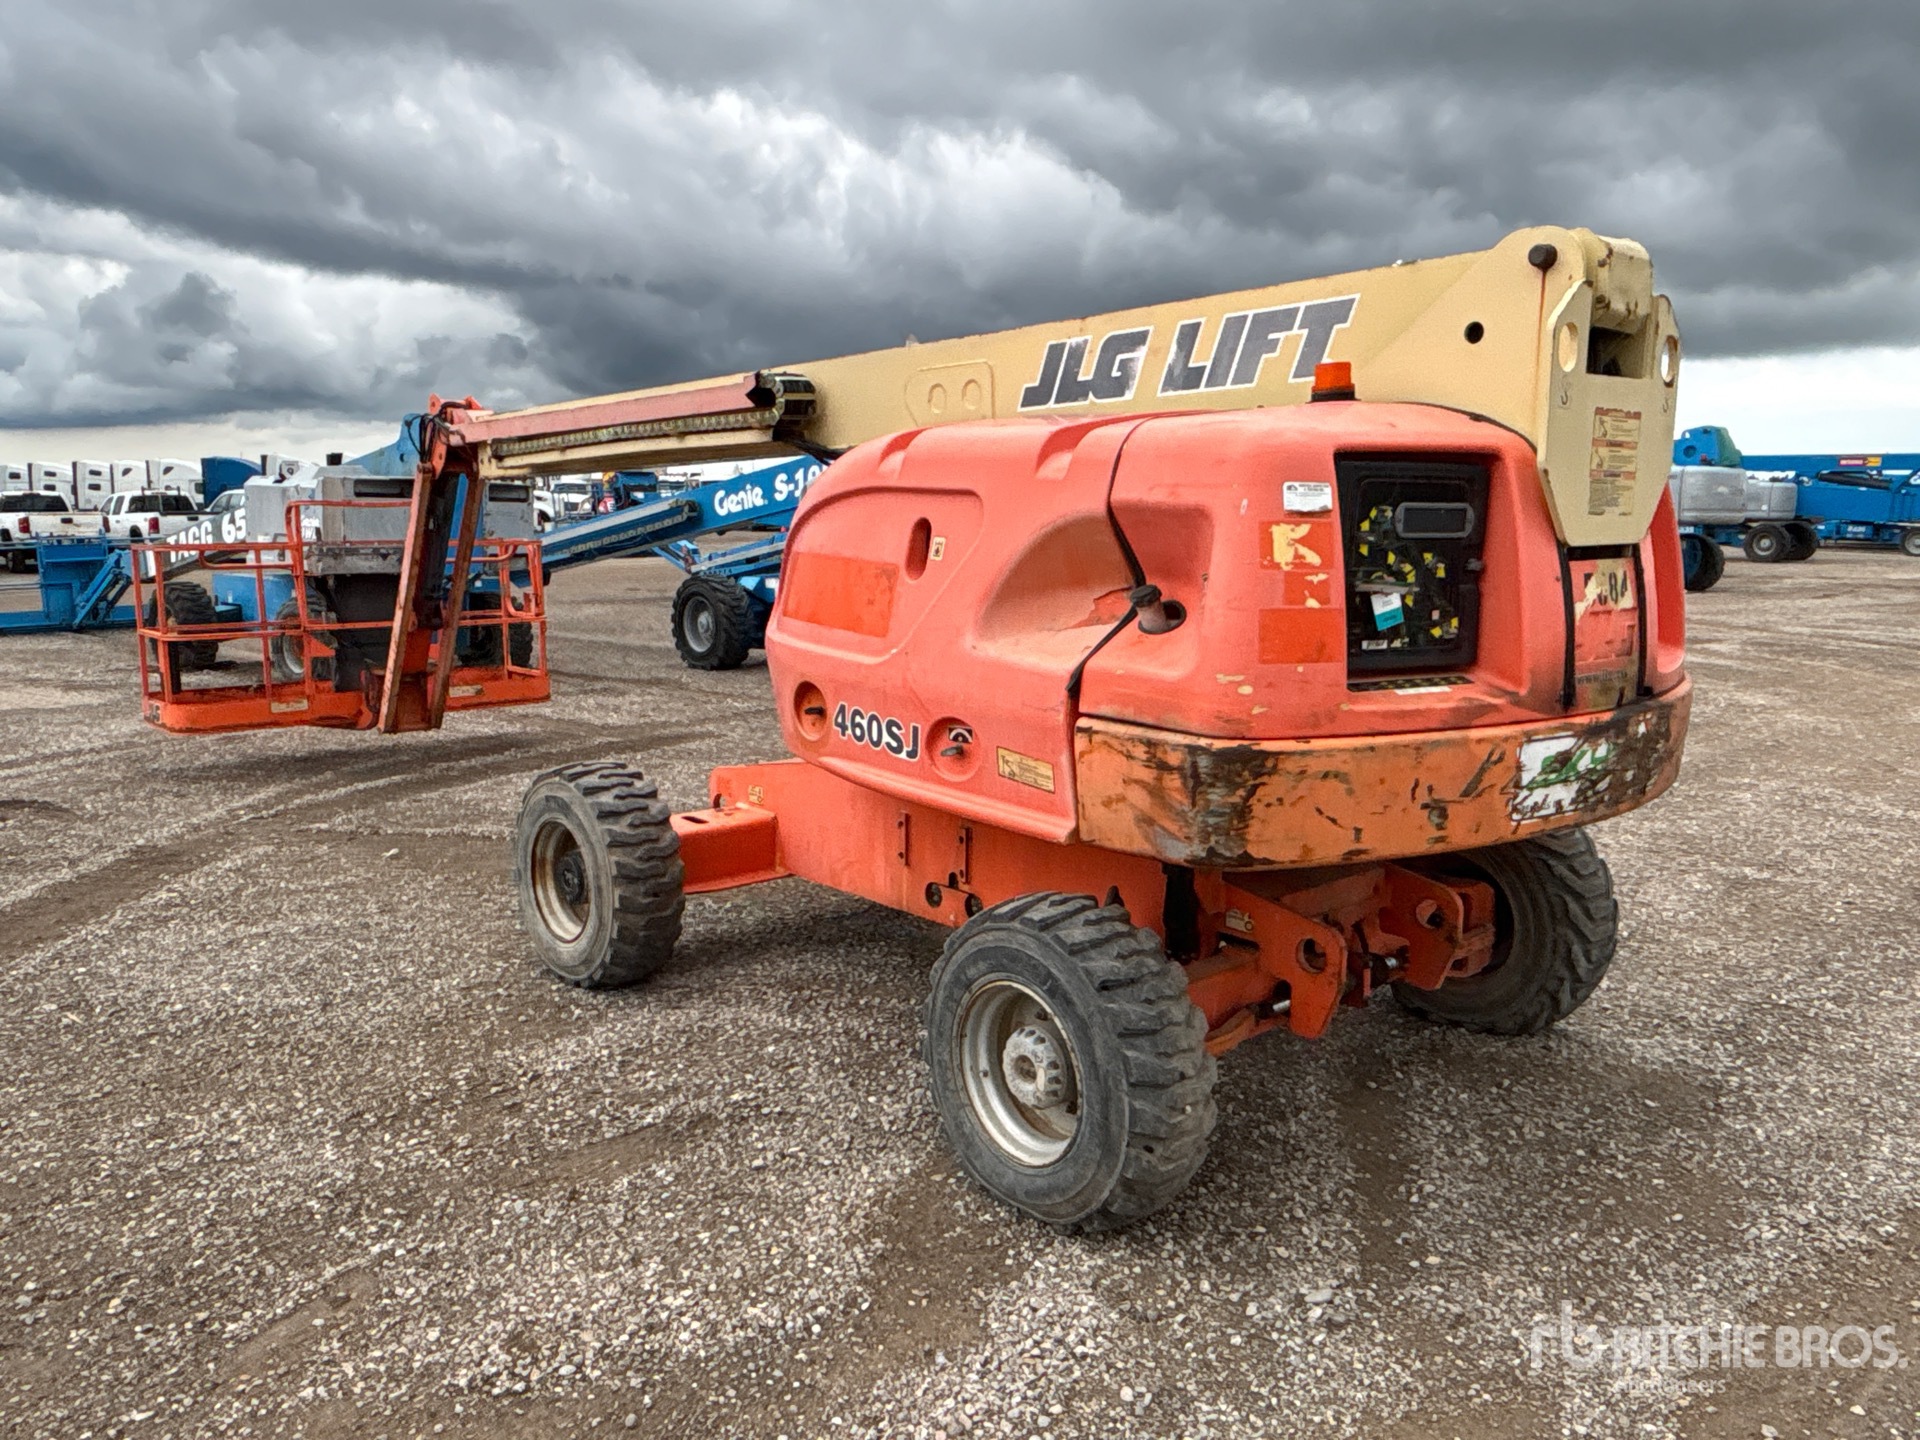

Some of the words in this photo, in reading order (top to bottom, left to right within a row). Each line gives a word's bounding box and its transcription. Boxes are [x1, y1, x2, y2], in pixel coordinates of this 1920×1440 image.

[1018, 326, 1154, 411] JLG
[1157, 294, 1361, 396] LIFT
[714, 483, 765, 516] Genie
[833, 701, 921, 762] 460SJ
